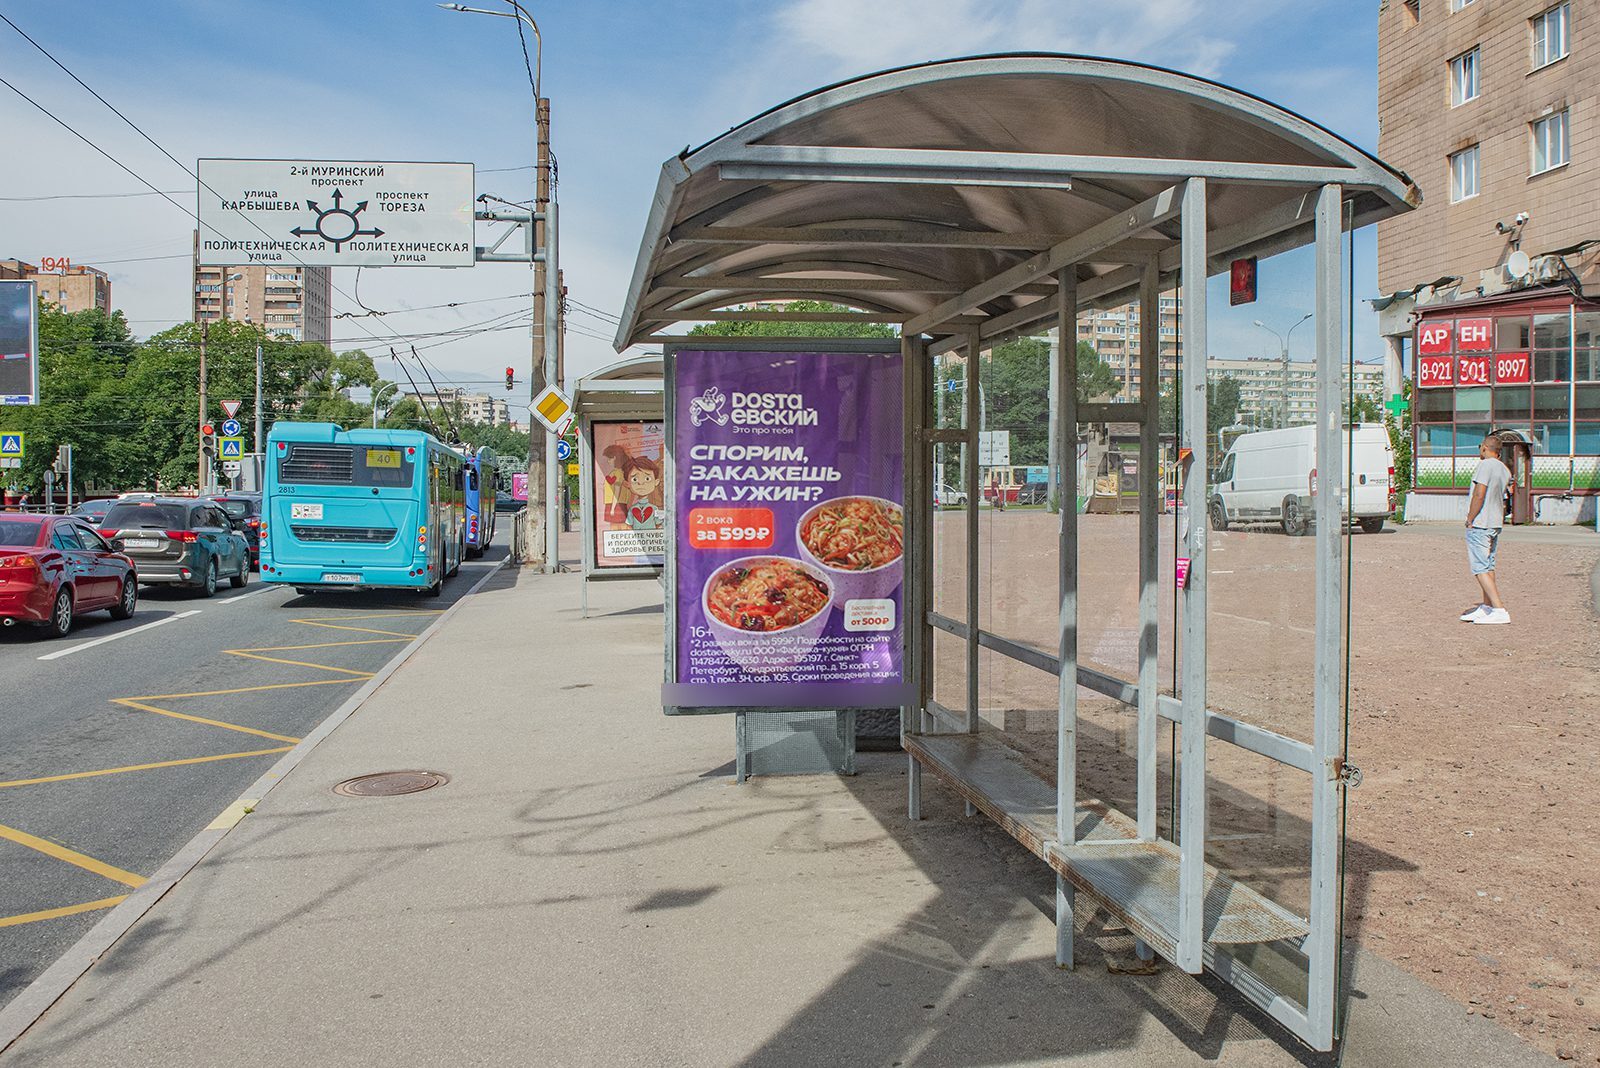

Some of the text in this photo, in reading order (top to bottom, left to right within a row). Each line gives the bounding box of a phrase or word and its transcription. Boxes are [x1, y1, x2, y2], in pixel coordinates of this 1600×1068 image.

[290, 165, 384, 177] 2-й МУРИНСКИЙ
[311, 178, 364, 187] проспект
[244, 190, 278, 200] улица
[376, 192, 429, 201] проспект
[222, 201, 300, 211] КАРБЫШЕВА
[379, 202, 426, 212] ТОРЕЗА
[204, 240, 326, 251] ПОЛИТЕХНИЧЕСКАЯ
[350, 242, 469, 252] ПОЛИТЕХНИЧЕСКАЯ
[248, 253, 282, 262] улица
[393, 254, 426, 263] улица
[41, 257, 70, 271] 1941
[1421, 326, 1487, 345] АР ЕН
[1421, 359, 1527, 382] 8-921 301 8997
[732, 426, 750, 434] Это
[772, 427, 794, 435] тебя
[377, 455, 391, 464] 40
[690, 445, 809, 464] СПОРИМ,
[689, 465, 842, 482] ЗАКАЖЕШЬ
[278, 486, 296, 494] 2813
[690, 485, 824, 501] НА УЖИН?
[696, 514, 733, 525] 2 вока
[697, 527, 770, 541] за 599₽
[614, 539, 665, 547] ПСИХОЛОГИЧЕ
[611, 546, 647, 554] ЗДОРОВЬЕ
[862, 617, 890, 626] 500₽
[690, 626, 714, 638] 16+
[797, 636, 855, 646] Подробности
[866, 635, 891, 643] сайте
[753, 646, 776, 655] ООО
[850, 644, 875, 652] ОГРН
[840, 662, 848, 670] 15
[873, 661, 880, 669] 5
[791, 673, 820, 682] Сроки
[820, 672, 871, 681] проведения
